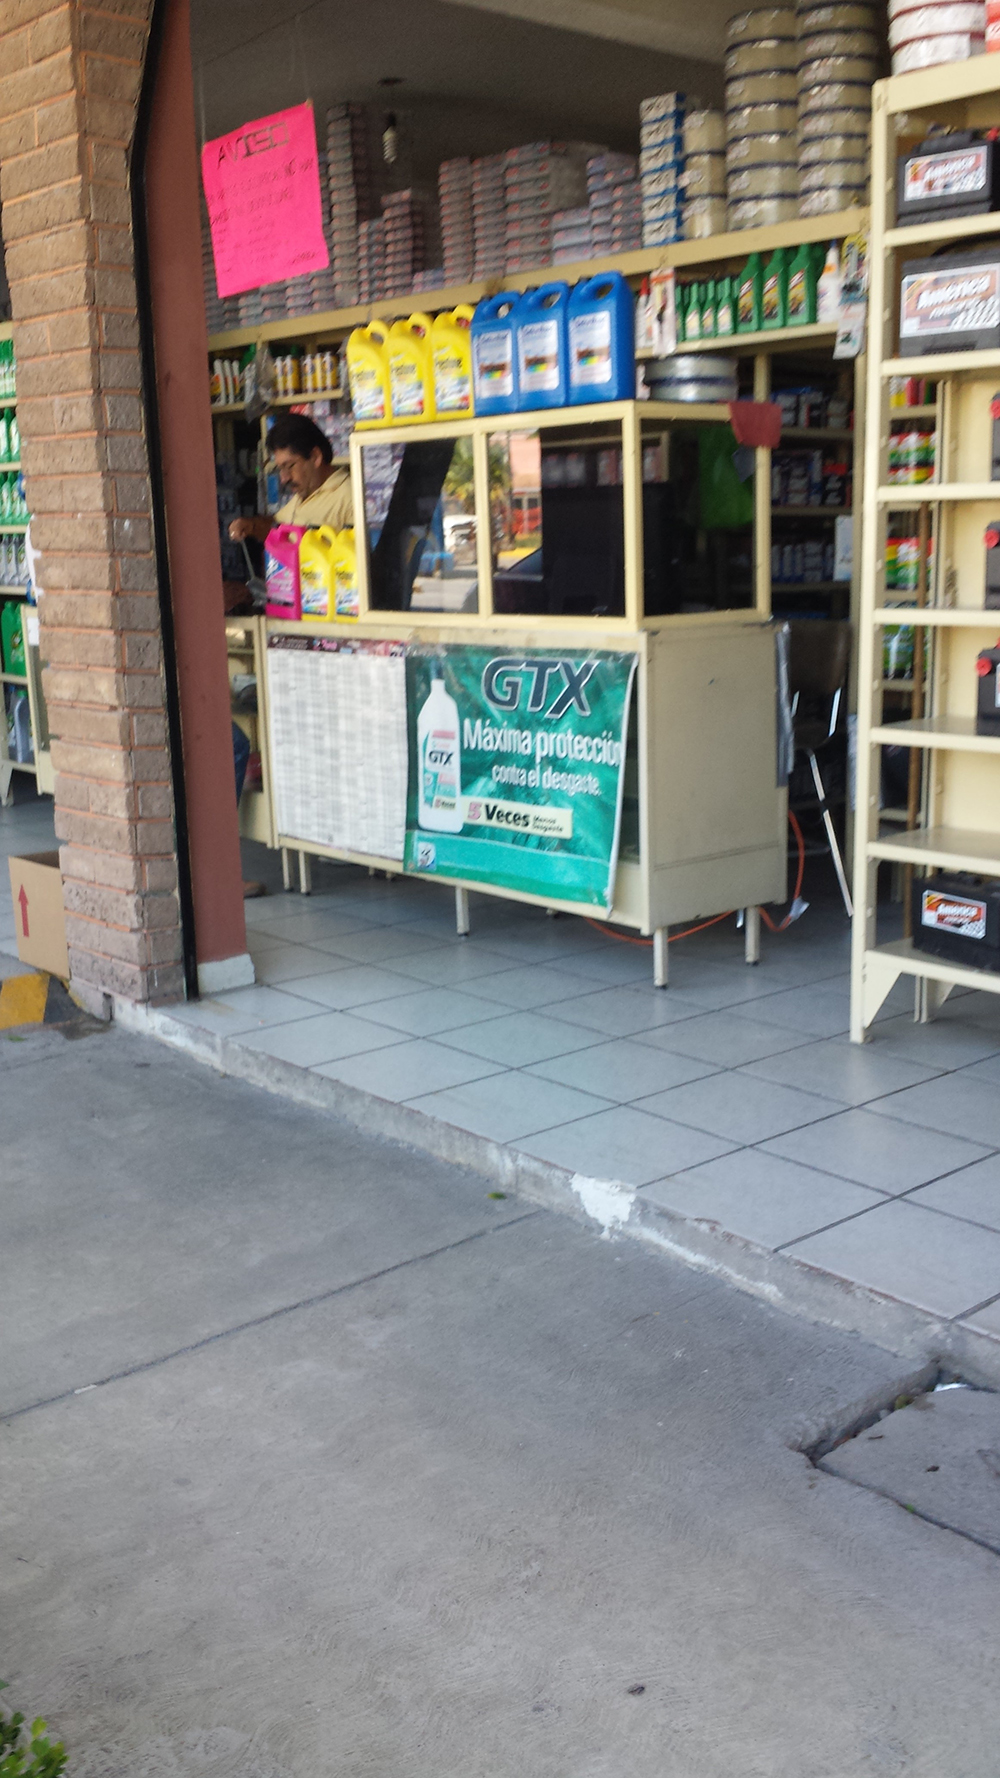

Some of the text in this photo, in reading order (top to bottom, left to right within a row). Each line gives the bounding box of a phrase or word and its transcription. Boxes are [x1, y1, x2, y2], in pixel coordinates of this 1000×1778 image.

[482, 657, 601, 718] GTX
[463, 717, 533, 756] Máxima
[428, 750, 454, 766] GTX
[527, 764, 541, 788] el
[467, 801, 482, 820] 5
[484, 804, 530, 828] Veces
